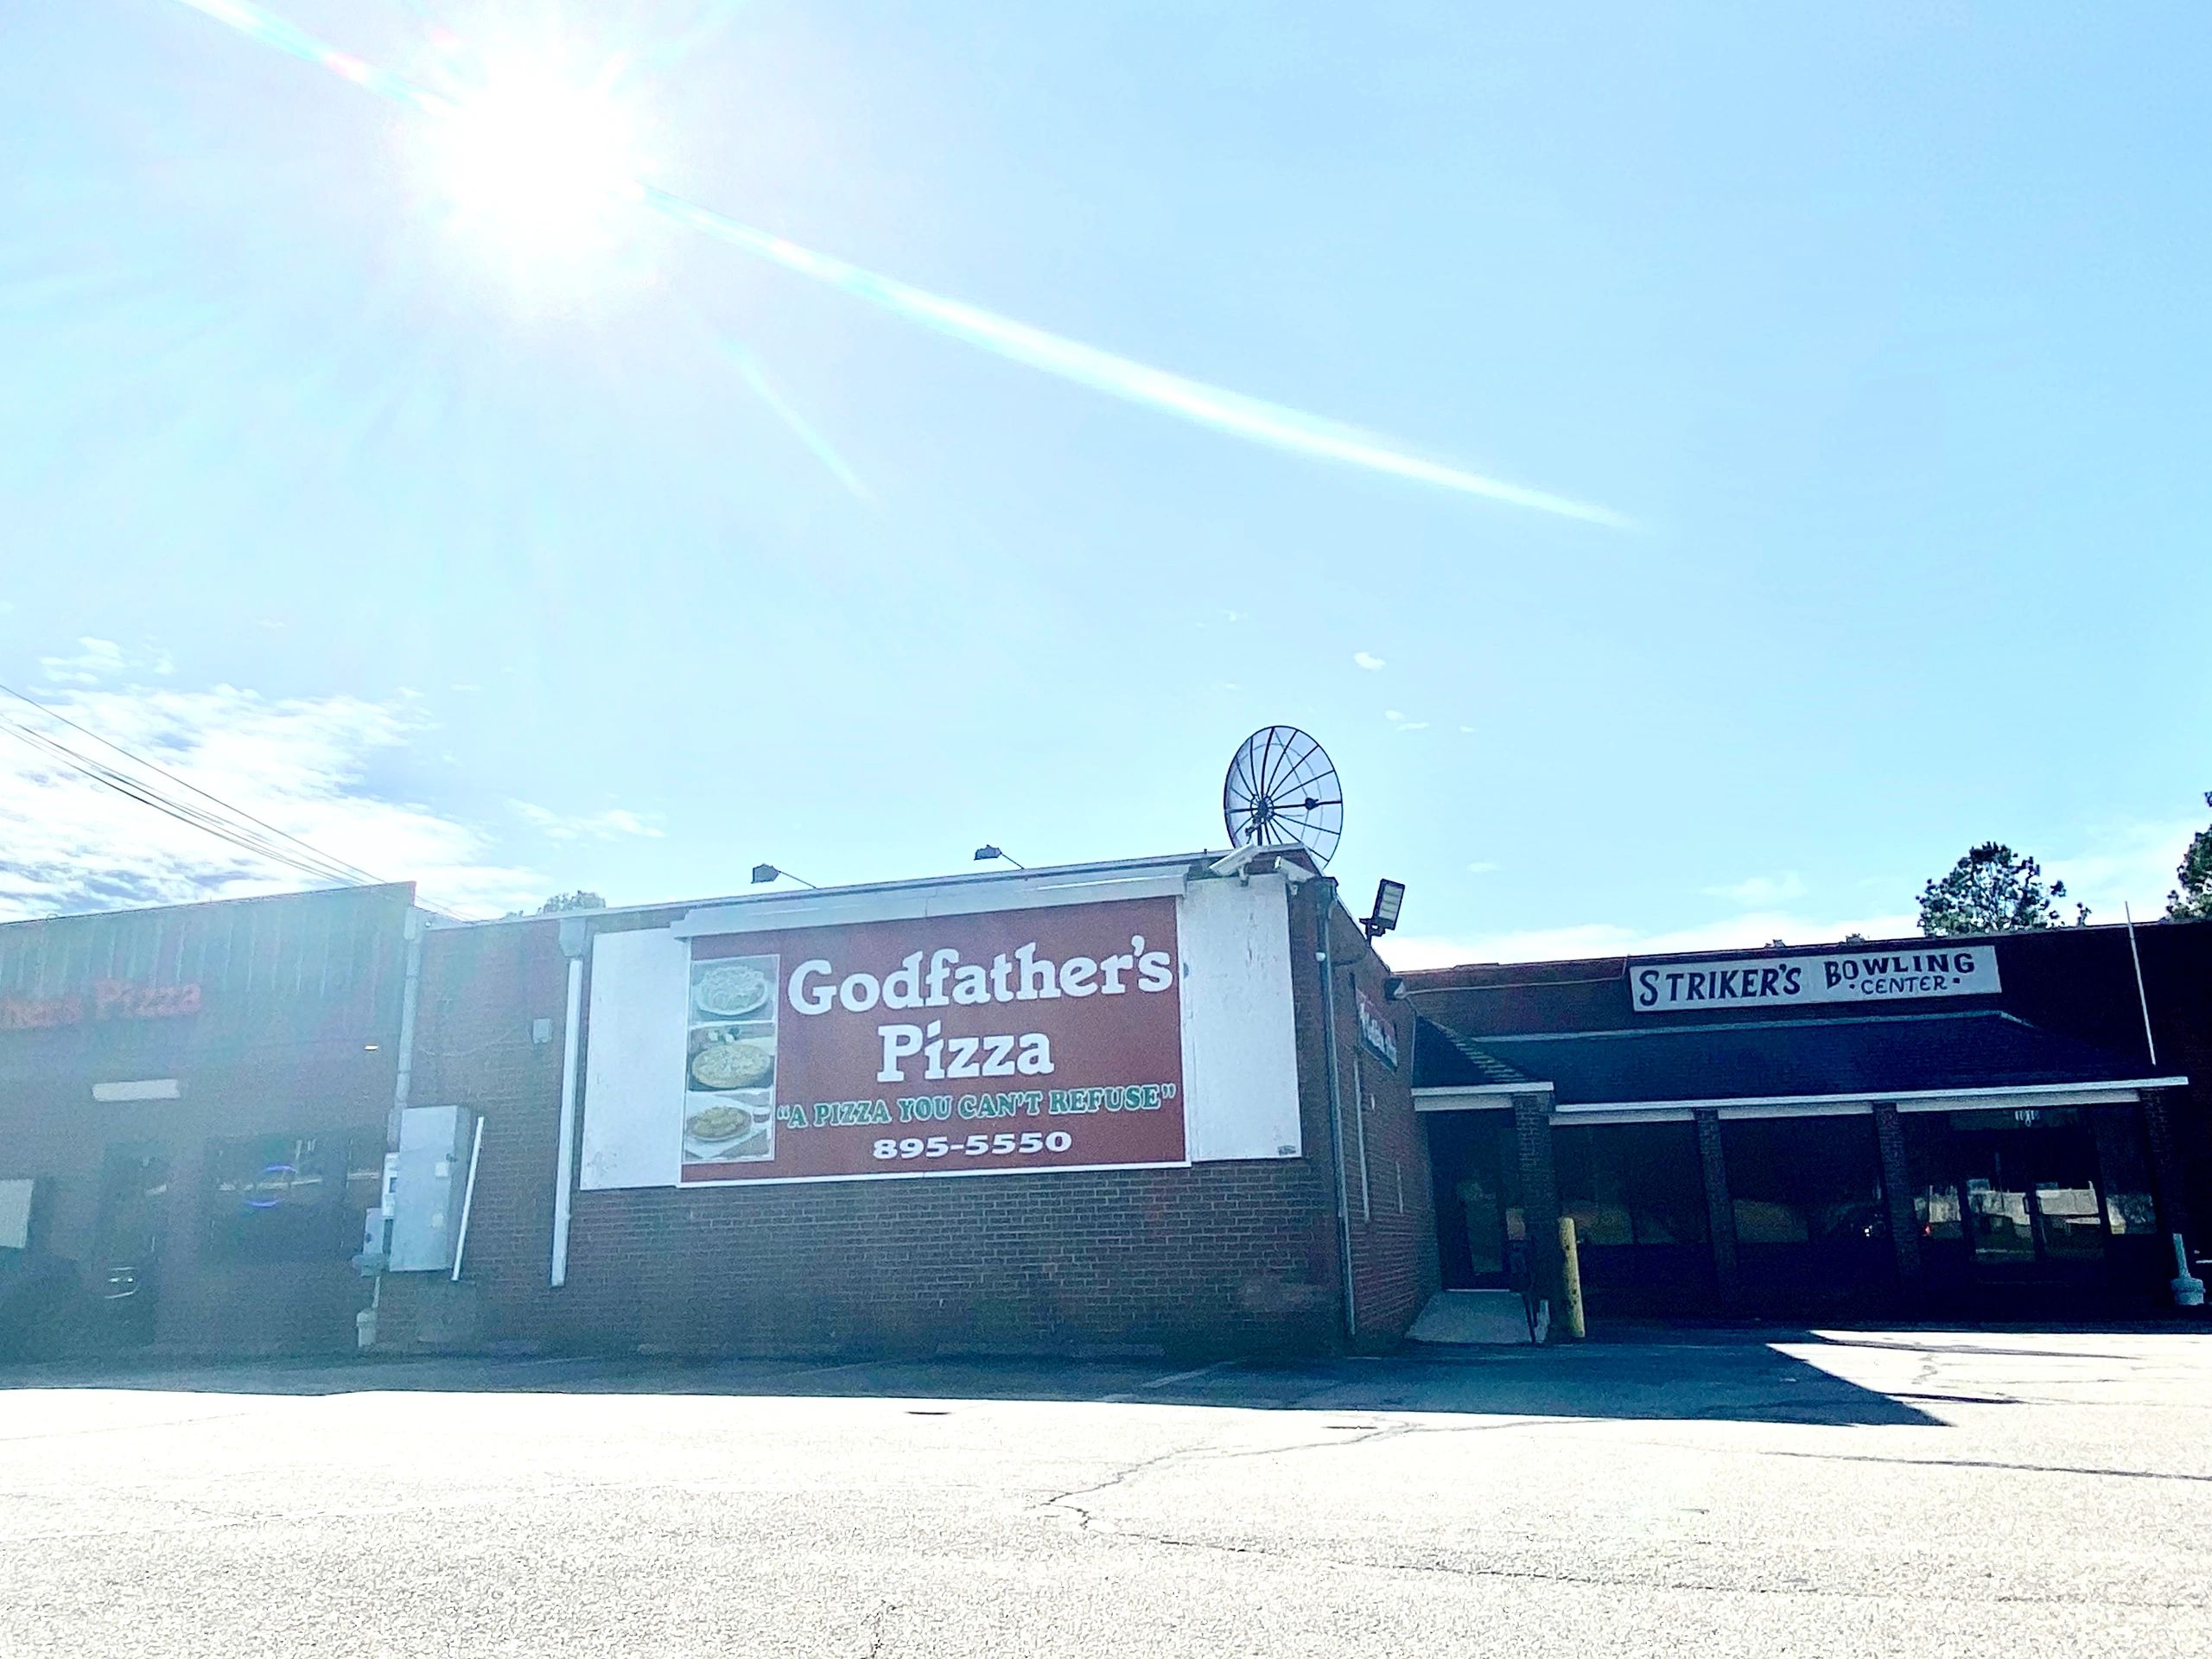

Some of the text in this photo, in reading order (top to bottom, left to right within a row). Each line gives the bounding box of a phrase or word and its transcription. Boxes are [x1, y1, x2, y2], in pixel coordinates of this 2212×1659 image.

[787, 935, 1173, 1015] Godfather's
[1639, 952, 1975, 1006] STRIKER'S BOWLING
[876, 1020, 1054, 1083] Pizza
[814, 1100, 892, 1126] PIZZA
[899, 1096, 952, 1122] YOU
[958, 1090, 1043, 1118] CAN'T
[1048, 1084, 1176, 1115] REFUSE"
[873, 1131, 1072, 1160] 895-5550
